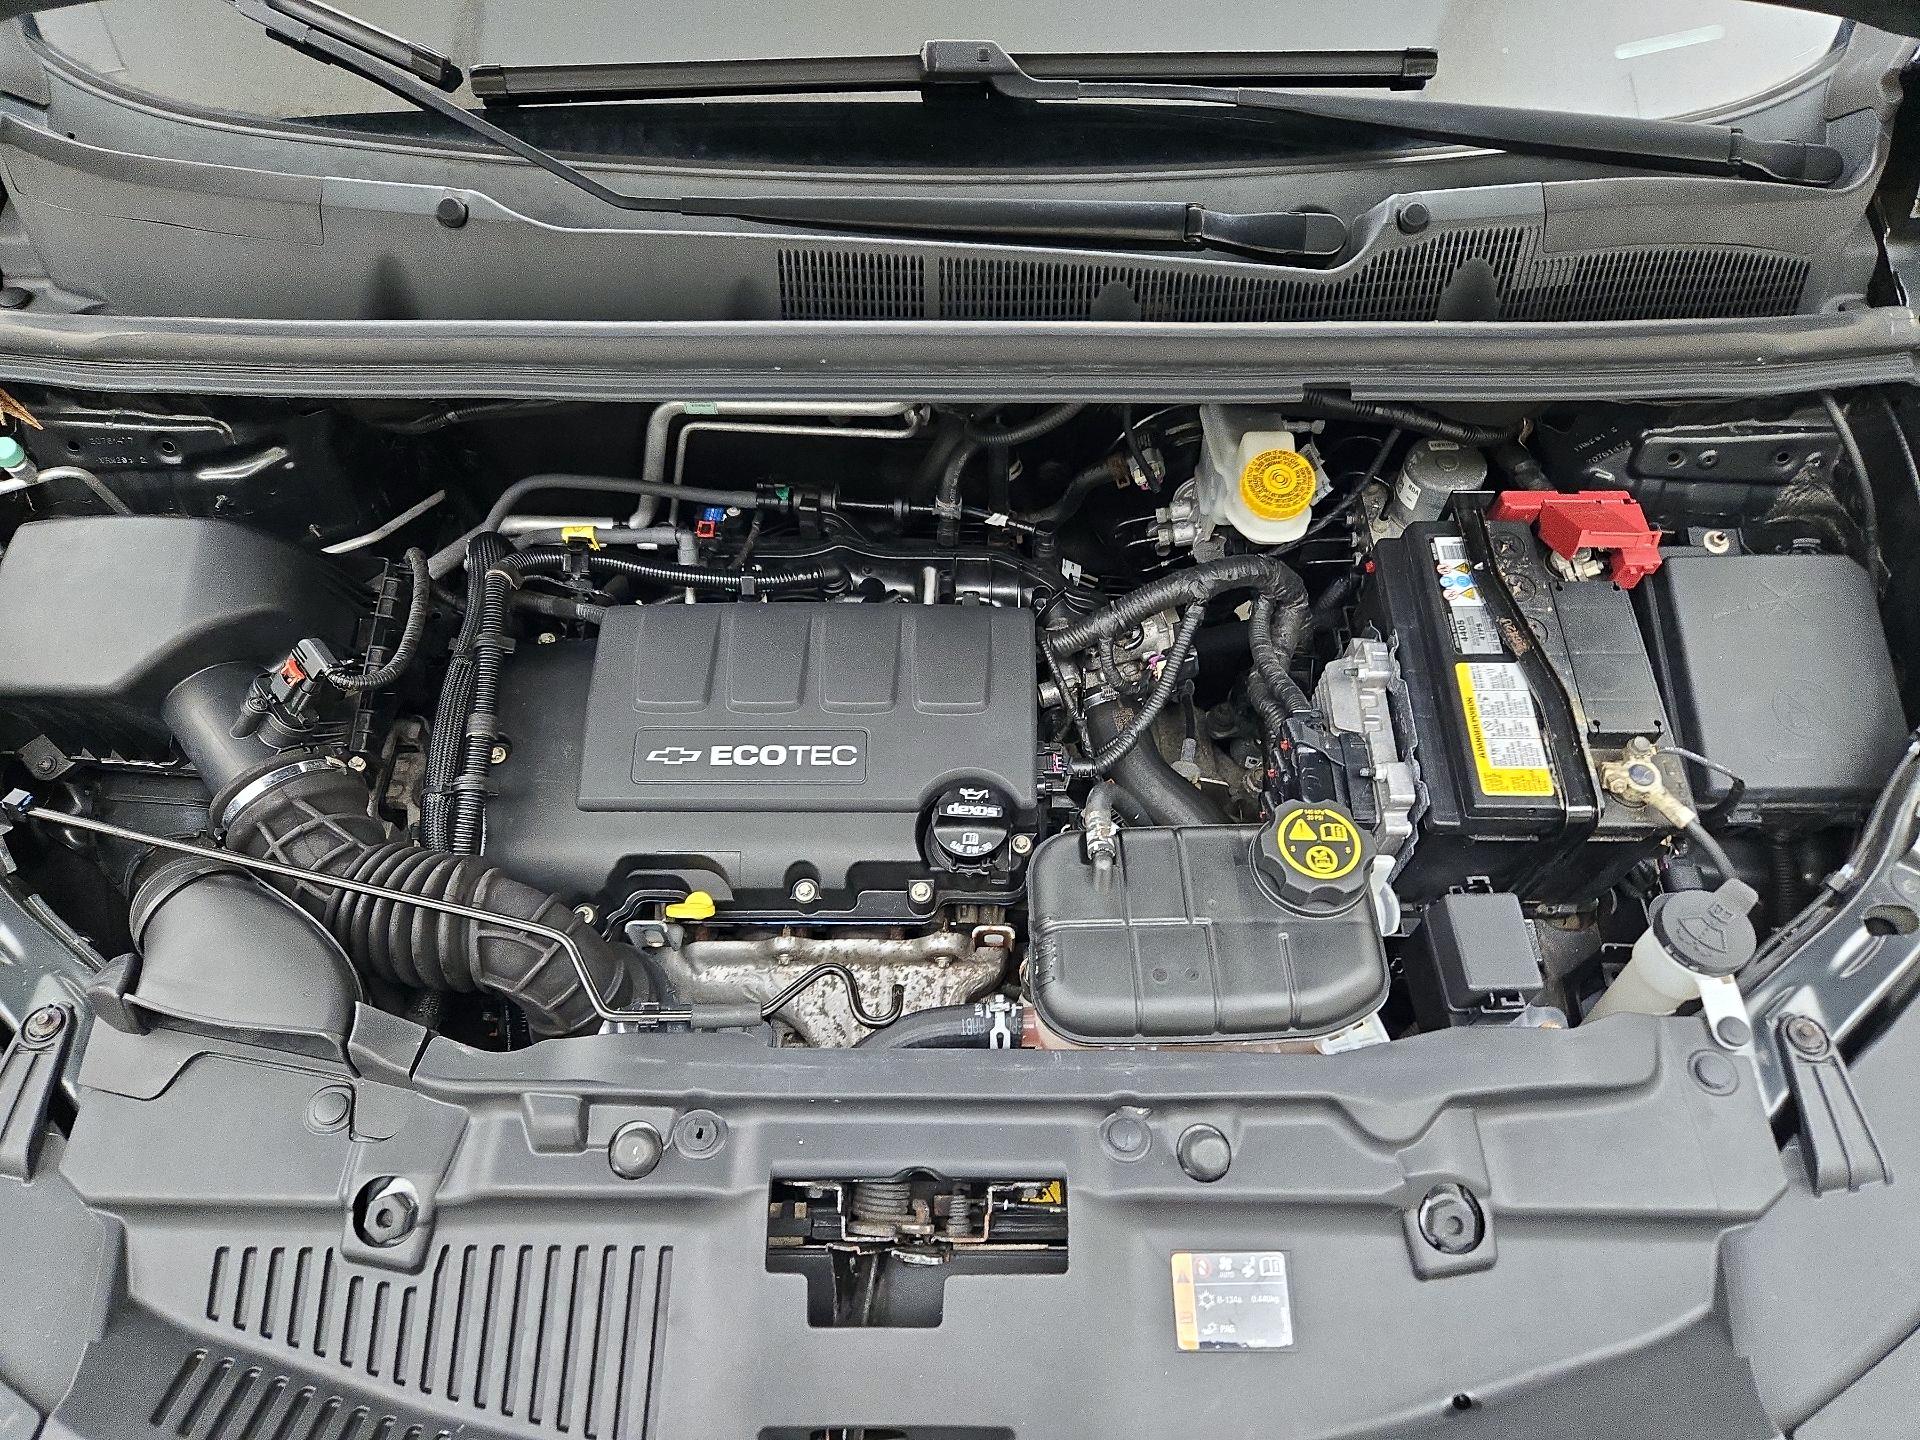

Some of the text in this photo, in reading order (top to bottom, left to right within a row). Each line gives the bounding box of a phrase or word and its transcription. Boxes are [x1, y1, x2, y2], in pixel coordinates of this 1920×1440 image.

[709, 745, 858, 766] ECOTEC
[946, 802, 999, 817] dexos
[949, 840, 965, 852] SAE
